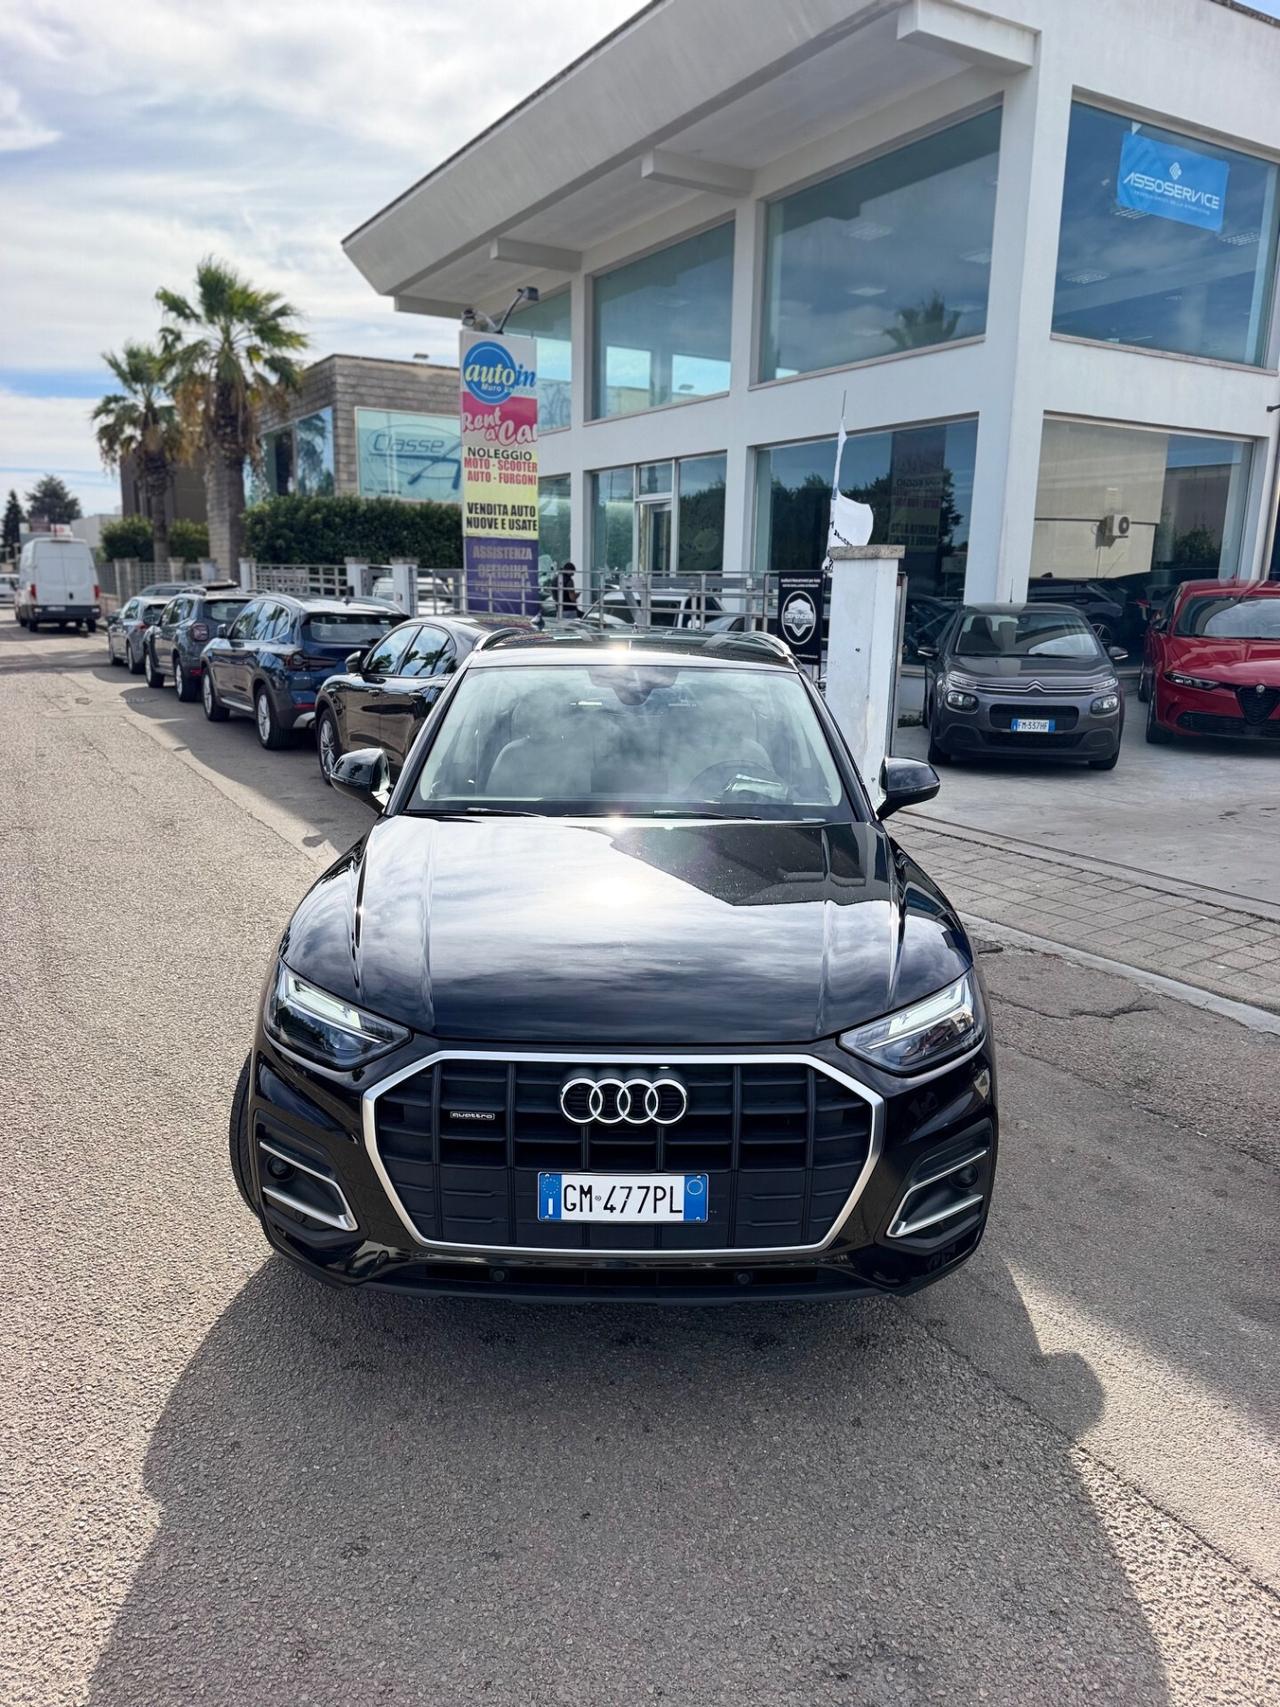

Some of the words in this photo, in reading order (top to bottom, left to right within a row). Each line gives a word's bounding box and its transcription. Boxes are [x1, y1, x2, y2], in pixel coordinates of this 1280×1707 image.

[1123, 171, 1220, 209] ASSOSERVICE
[481, 383, 502, 392] Muro
[463, 407, 501, 431] Rent
[374, 434, 444, 453] Classe
[467, 447, 532, 461] NOLEGGIO
[464, 457, 490, 470] MOTO
[498, 460, 538, 473] SCOOTER
[467, 471, 491, 483] AUTO
[499, 473, 536, 485] FURGONI
[467, 502, 508, 516] VENDITA
[511, 505, 536, 518] AUTO
[466, 517, 499, 530] NUOVE
[501, 518, 506, 530] E
[509, 519, 537, 531] USATE
[473, 545, 532, 560] ASSISTENZA
